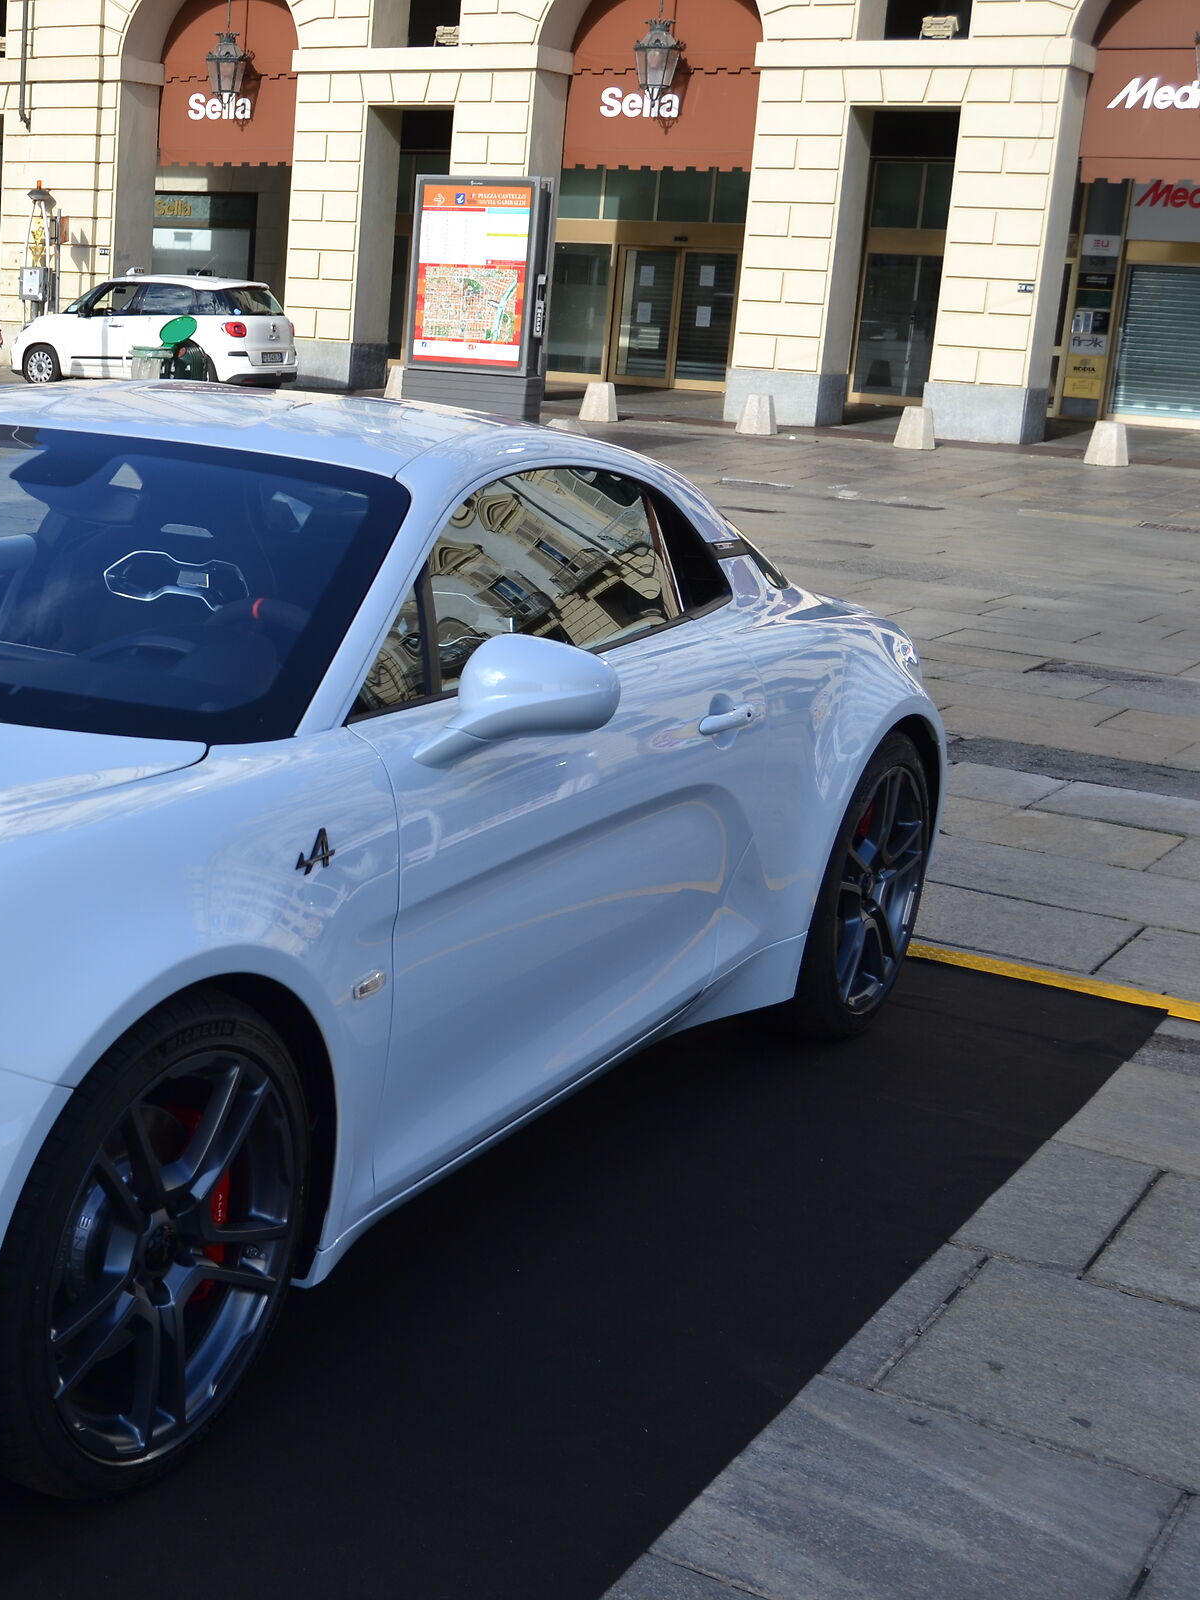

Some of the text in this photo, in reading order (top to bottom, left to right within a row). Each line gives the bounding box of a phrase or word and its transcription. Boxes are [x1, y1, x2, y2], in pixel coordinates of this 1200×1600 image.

[188, 92, 252, 120] Sella
[600, 87, 680, 118] Sella
[155, 199, 192, 216] Sella
